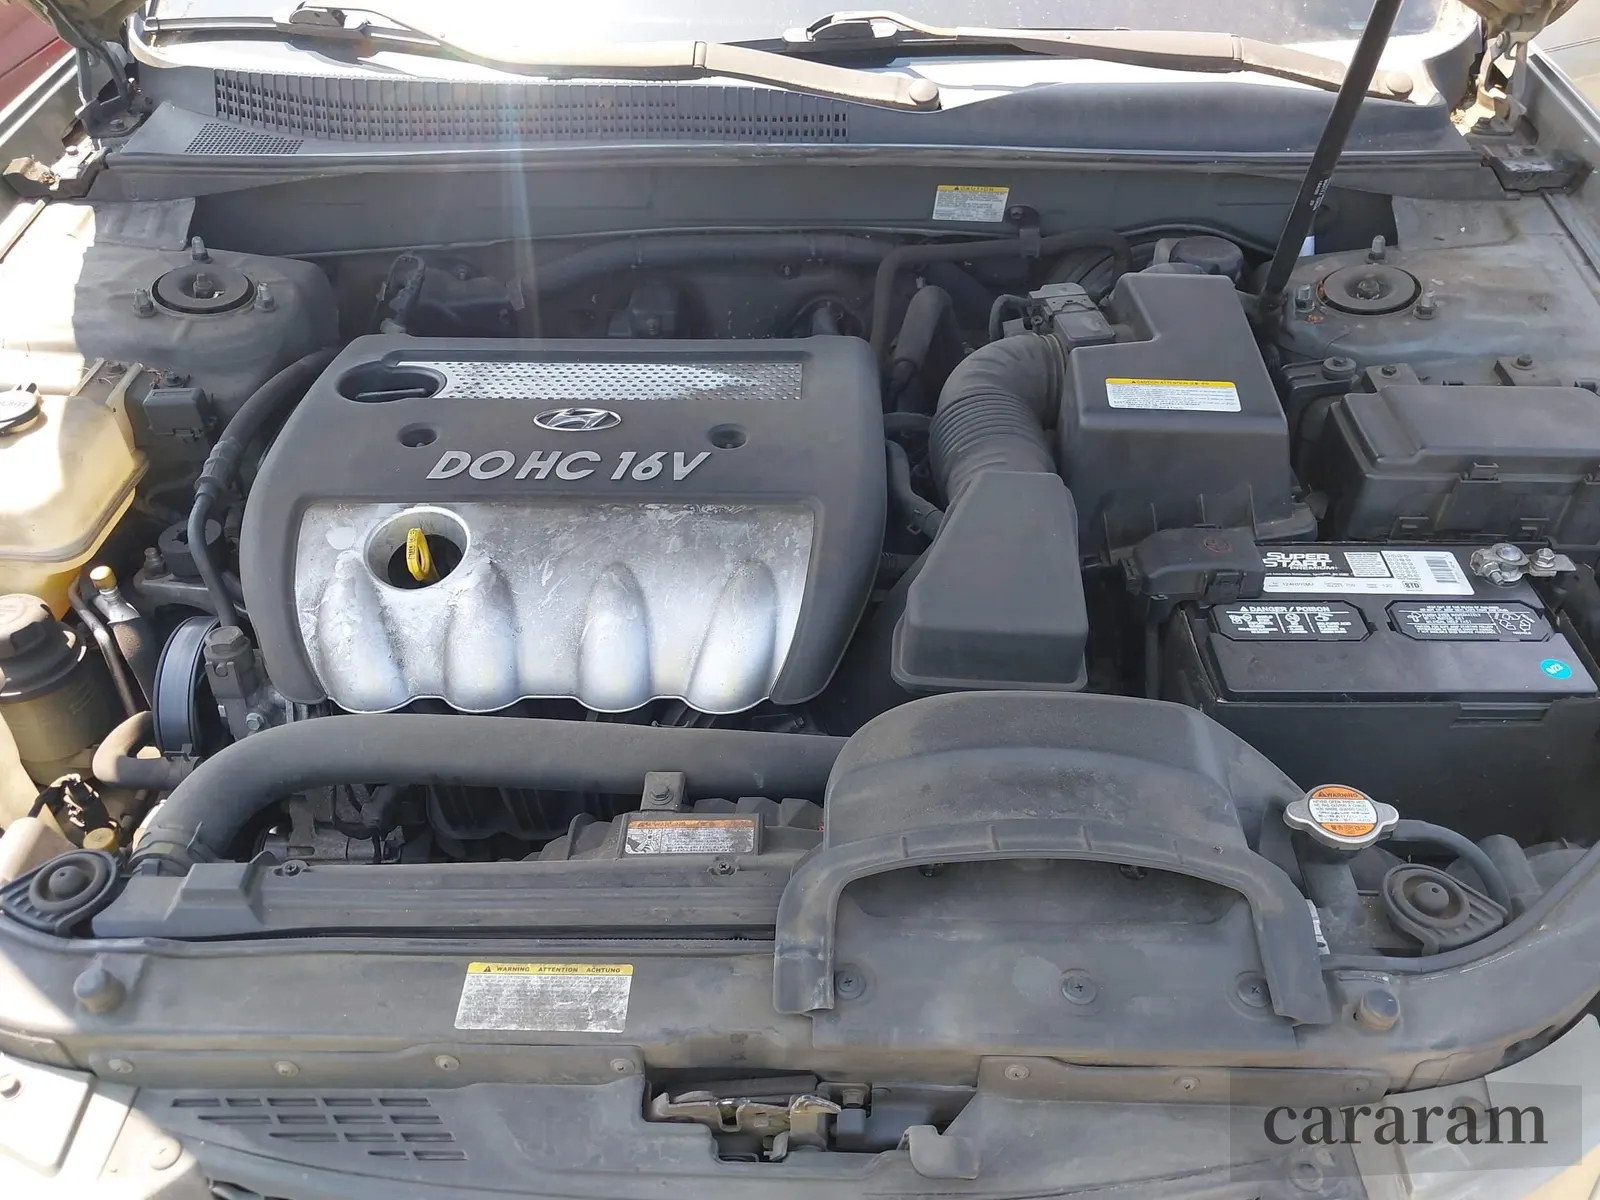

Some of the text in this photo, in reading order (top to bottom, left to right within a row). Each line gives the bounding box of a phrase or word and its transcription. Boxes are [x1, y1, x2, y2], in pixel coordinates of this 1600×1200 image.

[425, 450, 712, 481] DOHC 16V
[1266, 551, 1331, 560] SUPER
[1262, 558, 1333, 568] START
